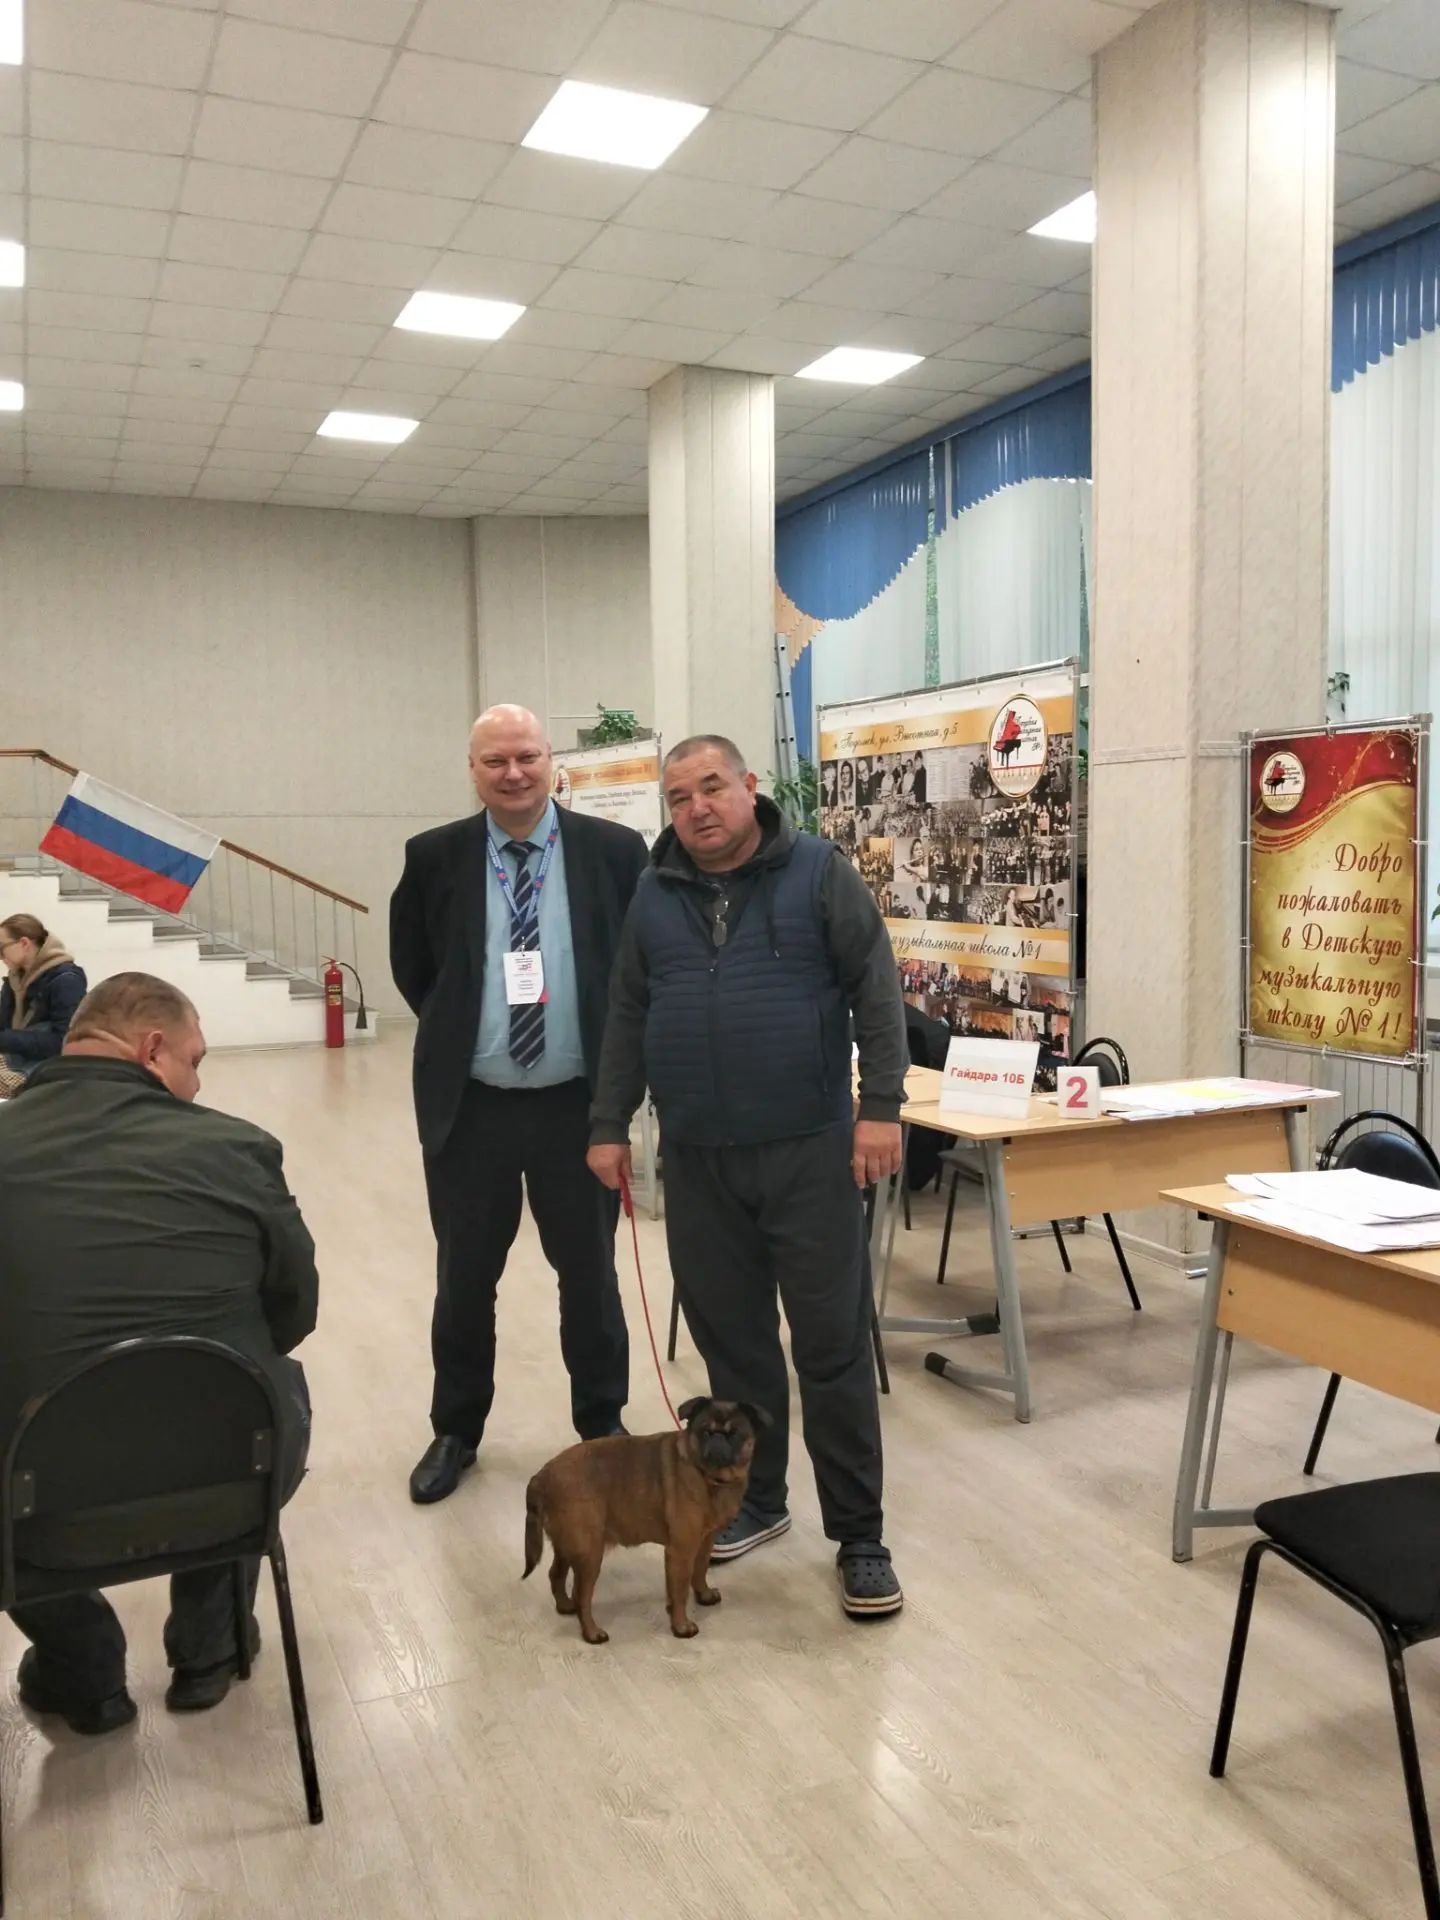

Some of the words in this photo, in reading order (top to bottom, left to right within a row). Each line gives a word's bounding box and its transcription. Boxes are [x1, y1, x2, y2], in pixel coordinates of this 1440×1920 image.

[1333, 841, 1402, 883] Добро
[1277, 885, 1402, 917] пожаловать
[969, 934, 1010, 956] школа
[1281, 926, 1291, 949] в
[1300, 922, 1402, 966] Детскую
[1257, 962, 1402, 1007] музыкальную
[1267, 998, 1326, 1040] школу
[950, 1067, 998, 1083] Гайдара
[1002, 1073, 1025, 1085] 10Б
[1066, 1075, 1089, 1108] 2
